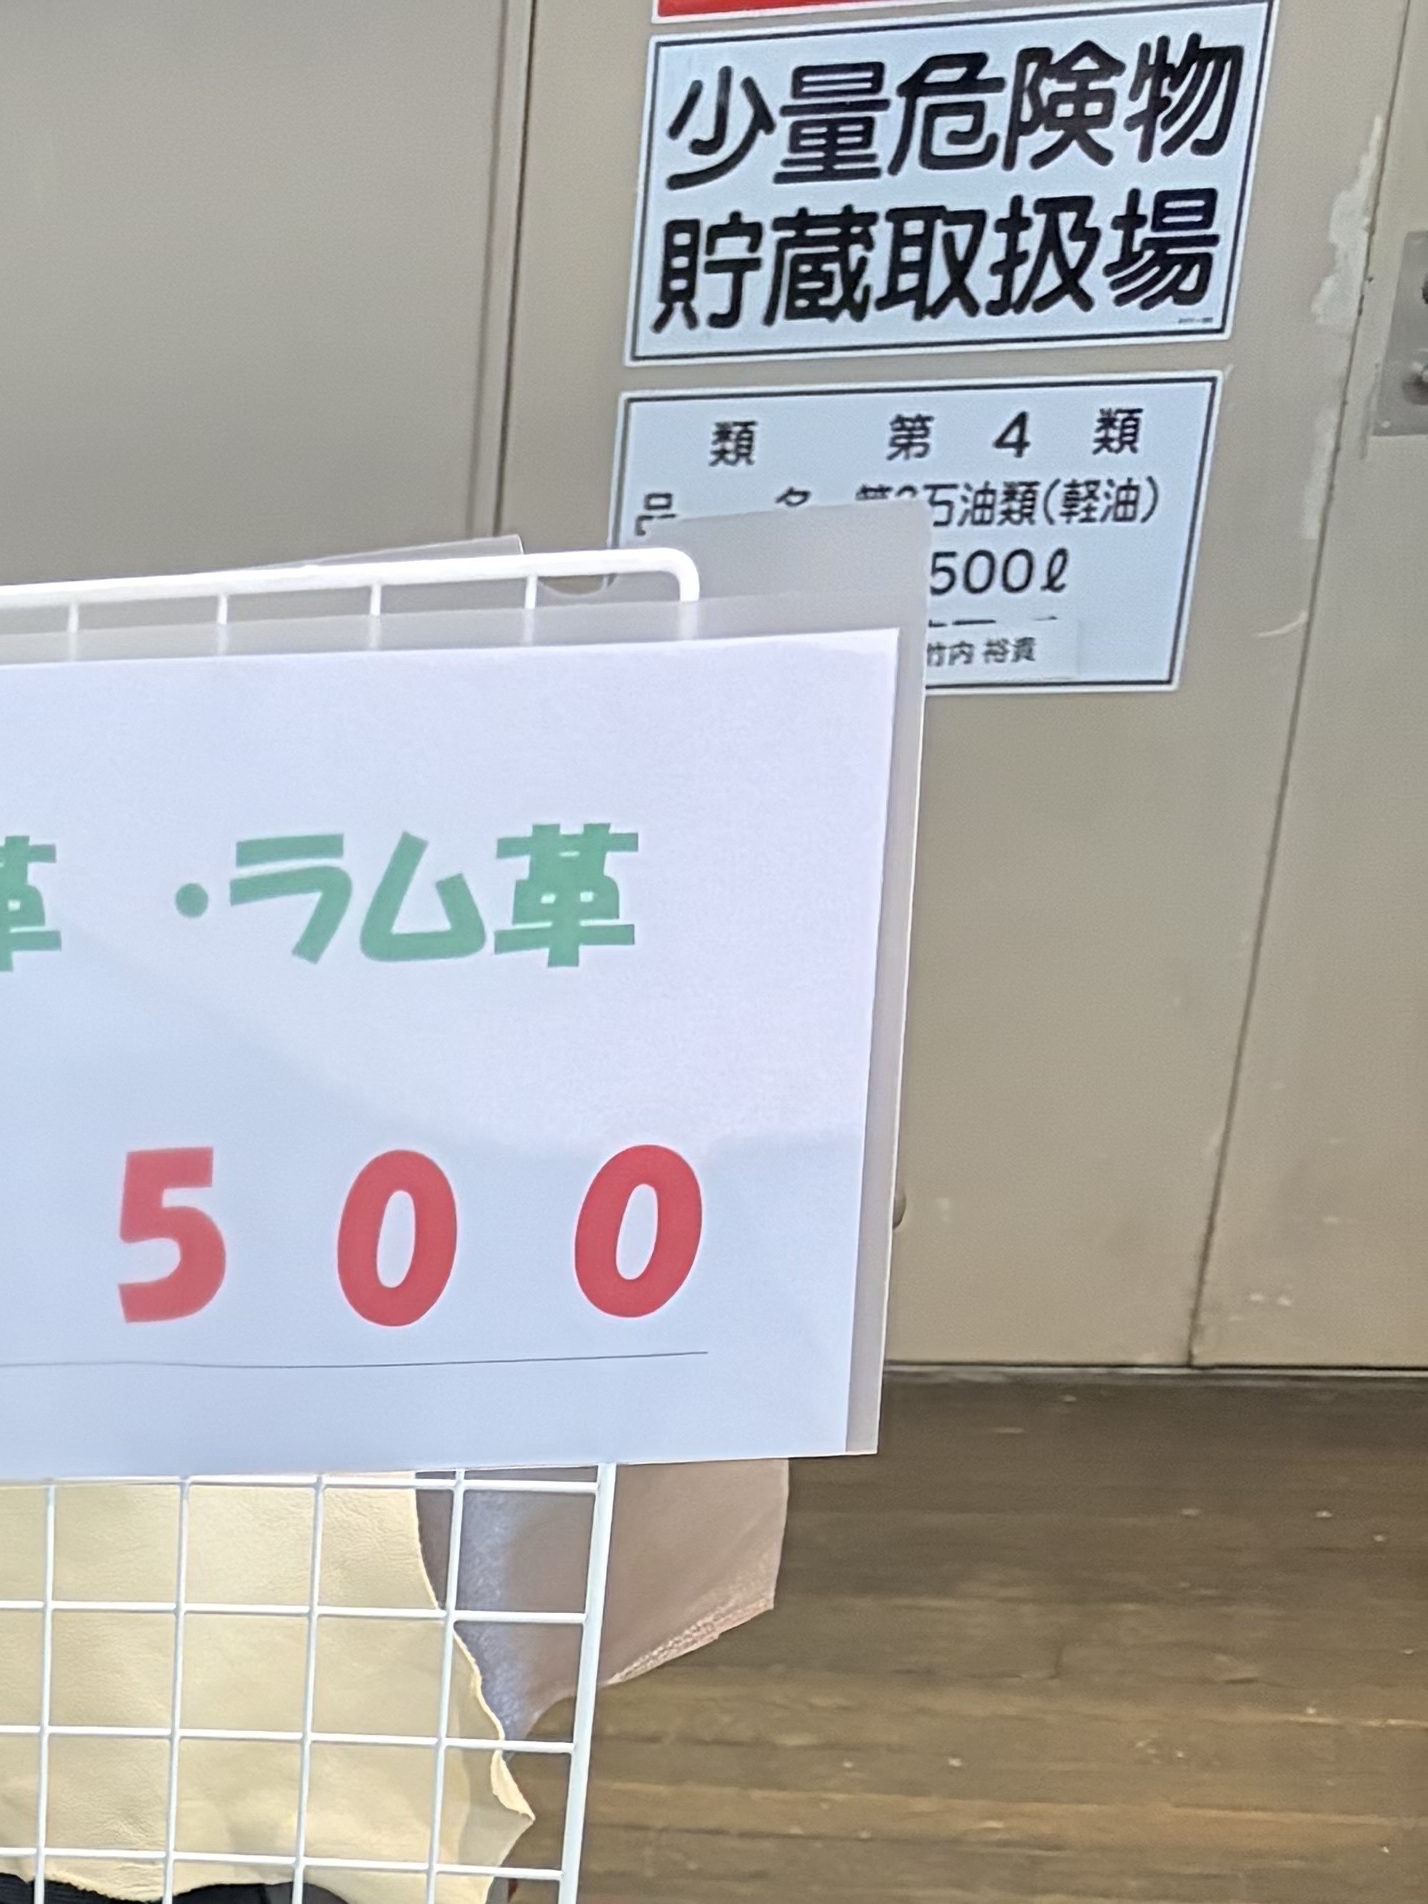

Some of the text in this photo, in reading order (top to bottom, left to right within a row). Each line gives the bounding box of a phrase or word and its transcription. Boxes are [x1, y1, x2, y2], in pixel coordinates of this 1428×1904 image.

[666, 32, 1245, 191] 少量危険物
[652, 187, 1221, 334] 貯蔵取扱場
[709, 420, 757, 467] 類
